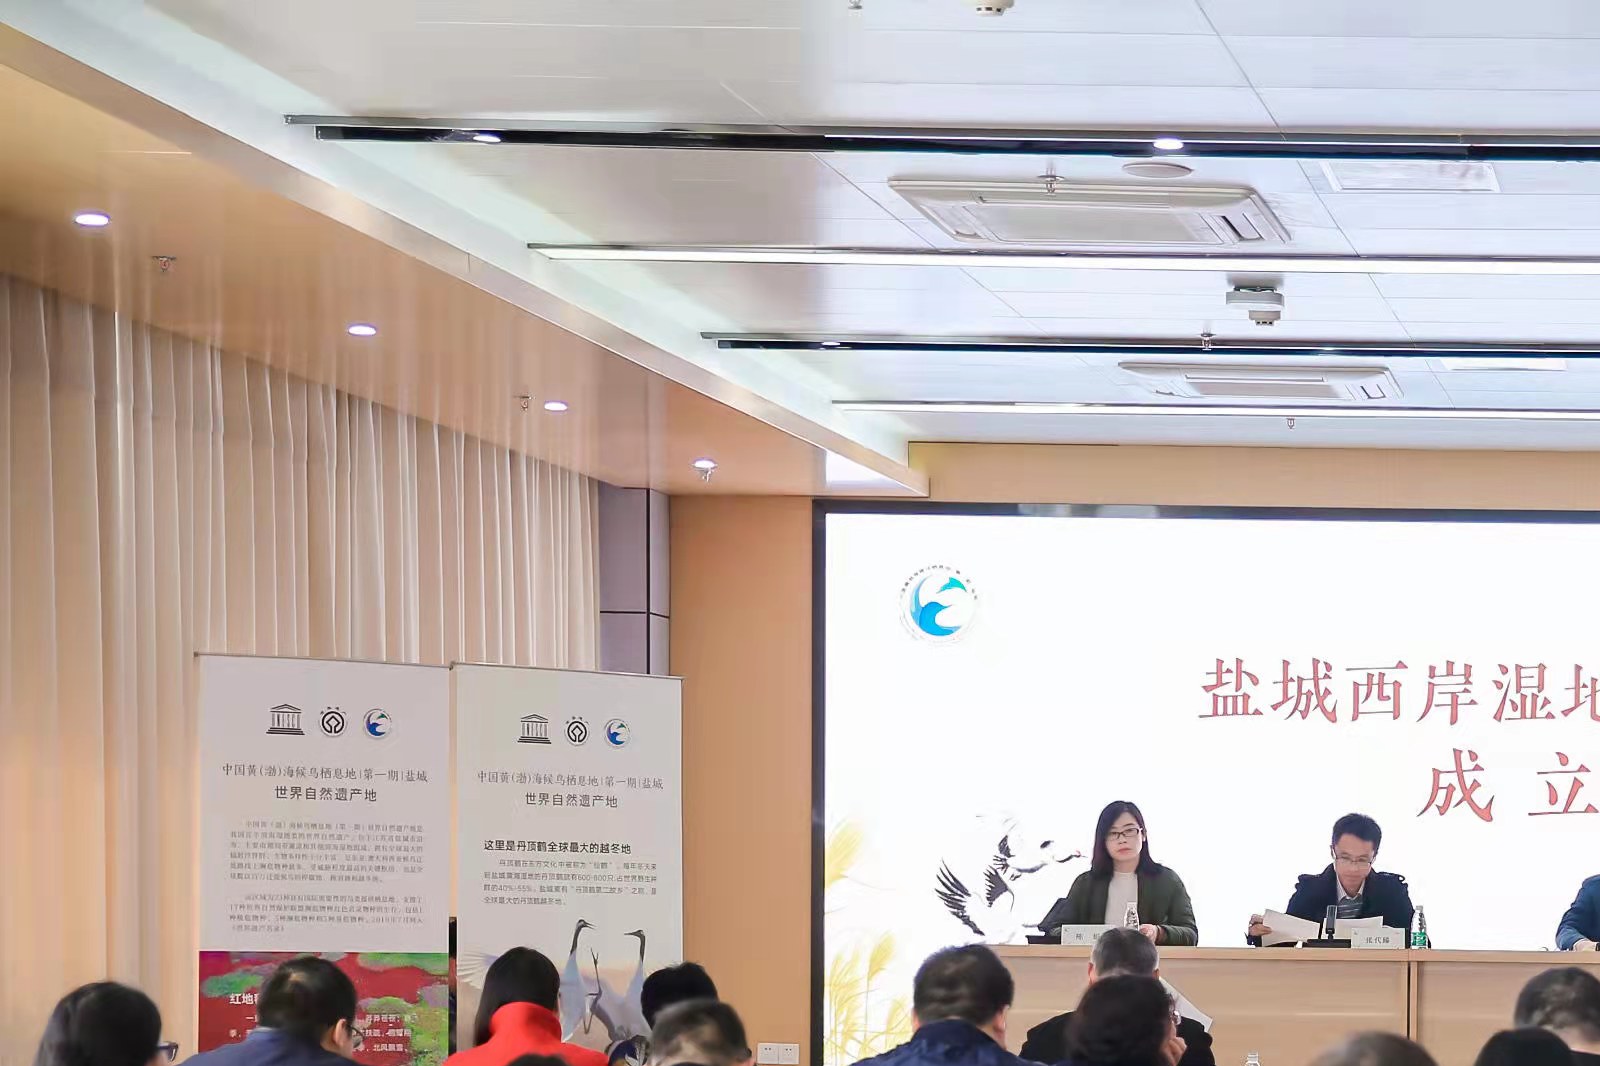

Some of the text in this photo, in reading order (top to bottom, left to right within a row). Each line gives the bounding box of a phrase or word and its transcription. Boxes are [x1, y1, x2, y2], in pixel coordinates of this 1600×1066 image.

[274, 785, 377, 802] 世界自然遗产地
[525, 792, 619, 808] 世界自然遗产地
[483, 840, 632, 855] 这里是丹顶鹤全球最大的越冬地
